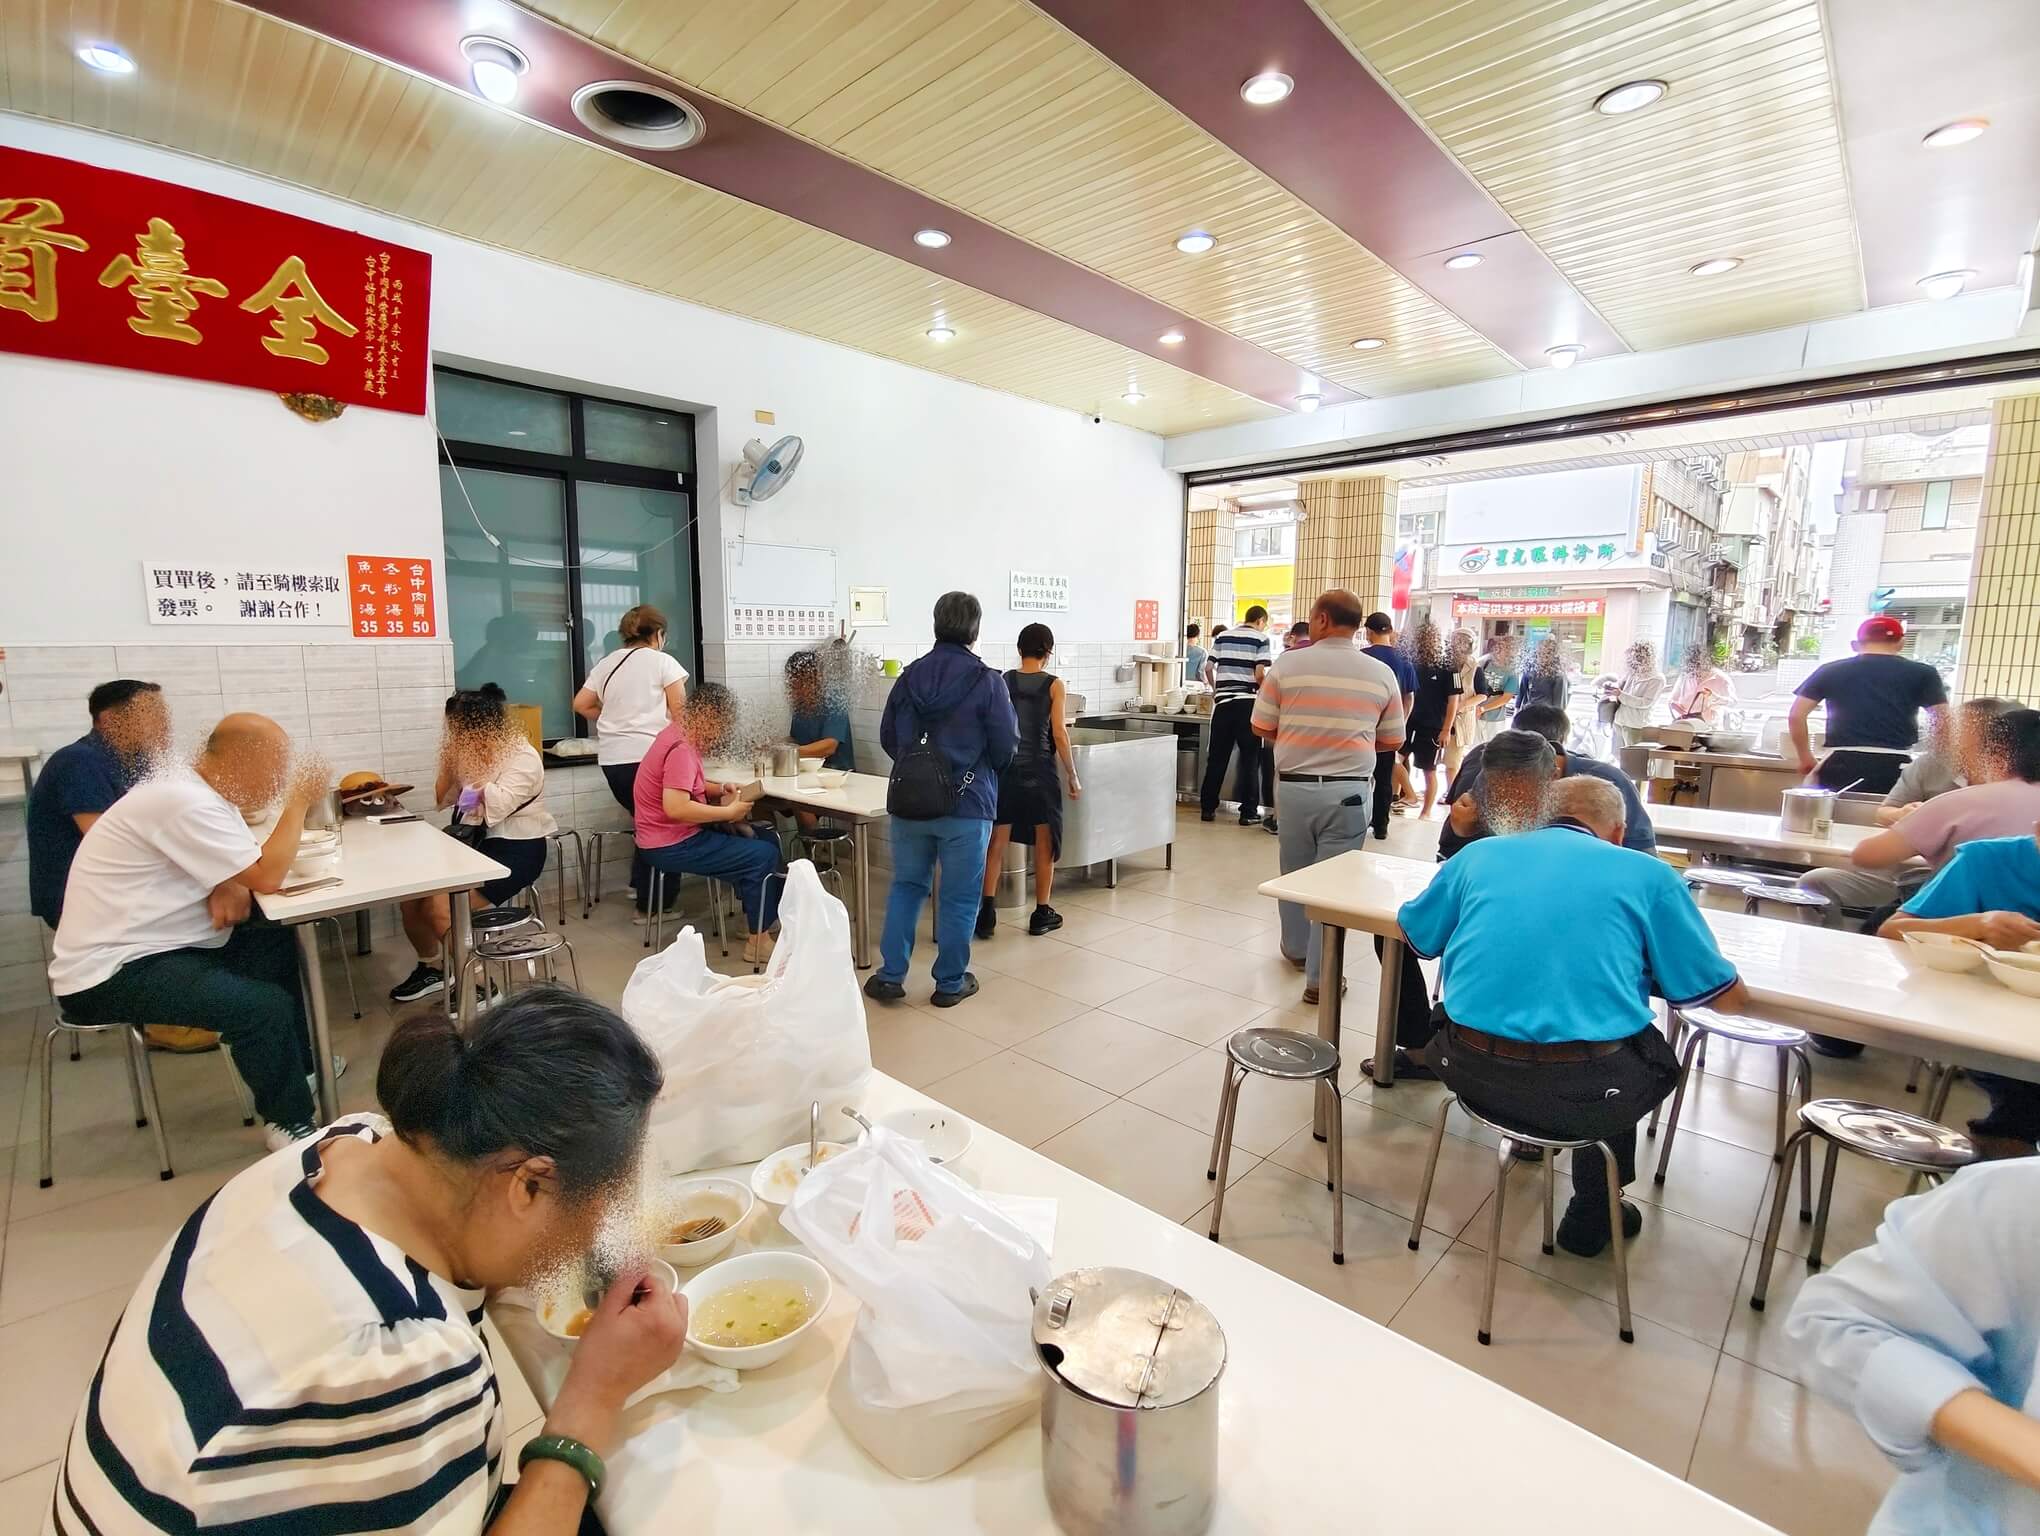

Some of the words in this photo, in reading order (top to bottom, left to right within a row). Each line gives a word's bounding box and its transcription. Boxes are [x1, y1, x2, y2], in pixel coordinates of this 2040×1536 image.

[153, 569, 340, 593] 買單後，請至騎樓索取
[357, 560, 377, 616] 魚丸湯
[382, 562, 403, 616] 冬粉湯
[158, 598, 213, 617] 發票。
[240, 600, 321, 618] 謝謝合作！
[360, 620, 378, 633] 35
[386, 620, 404, 633] 35
[412, 620, 430, 633] 50
